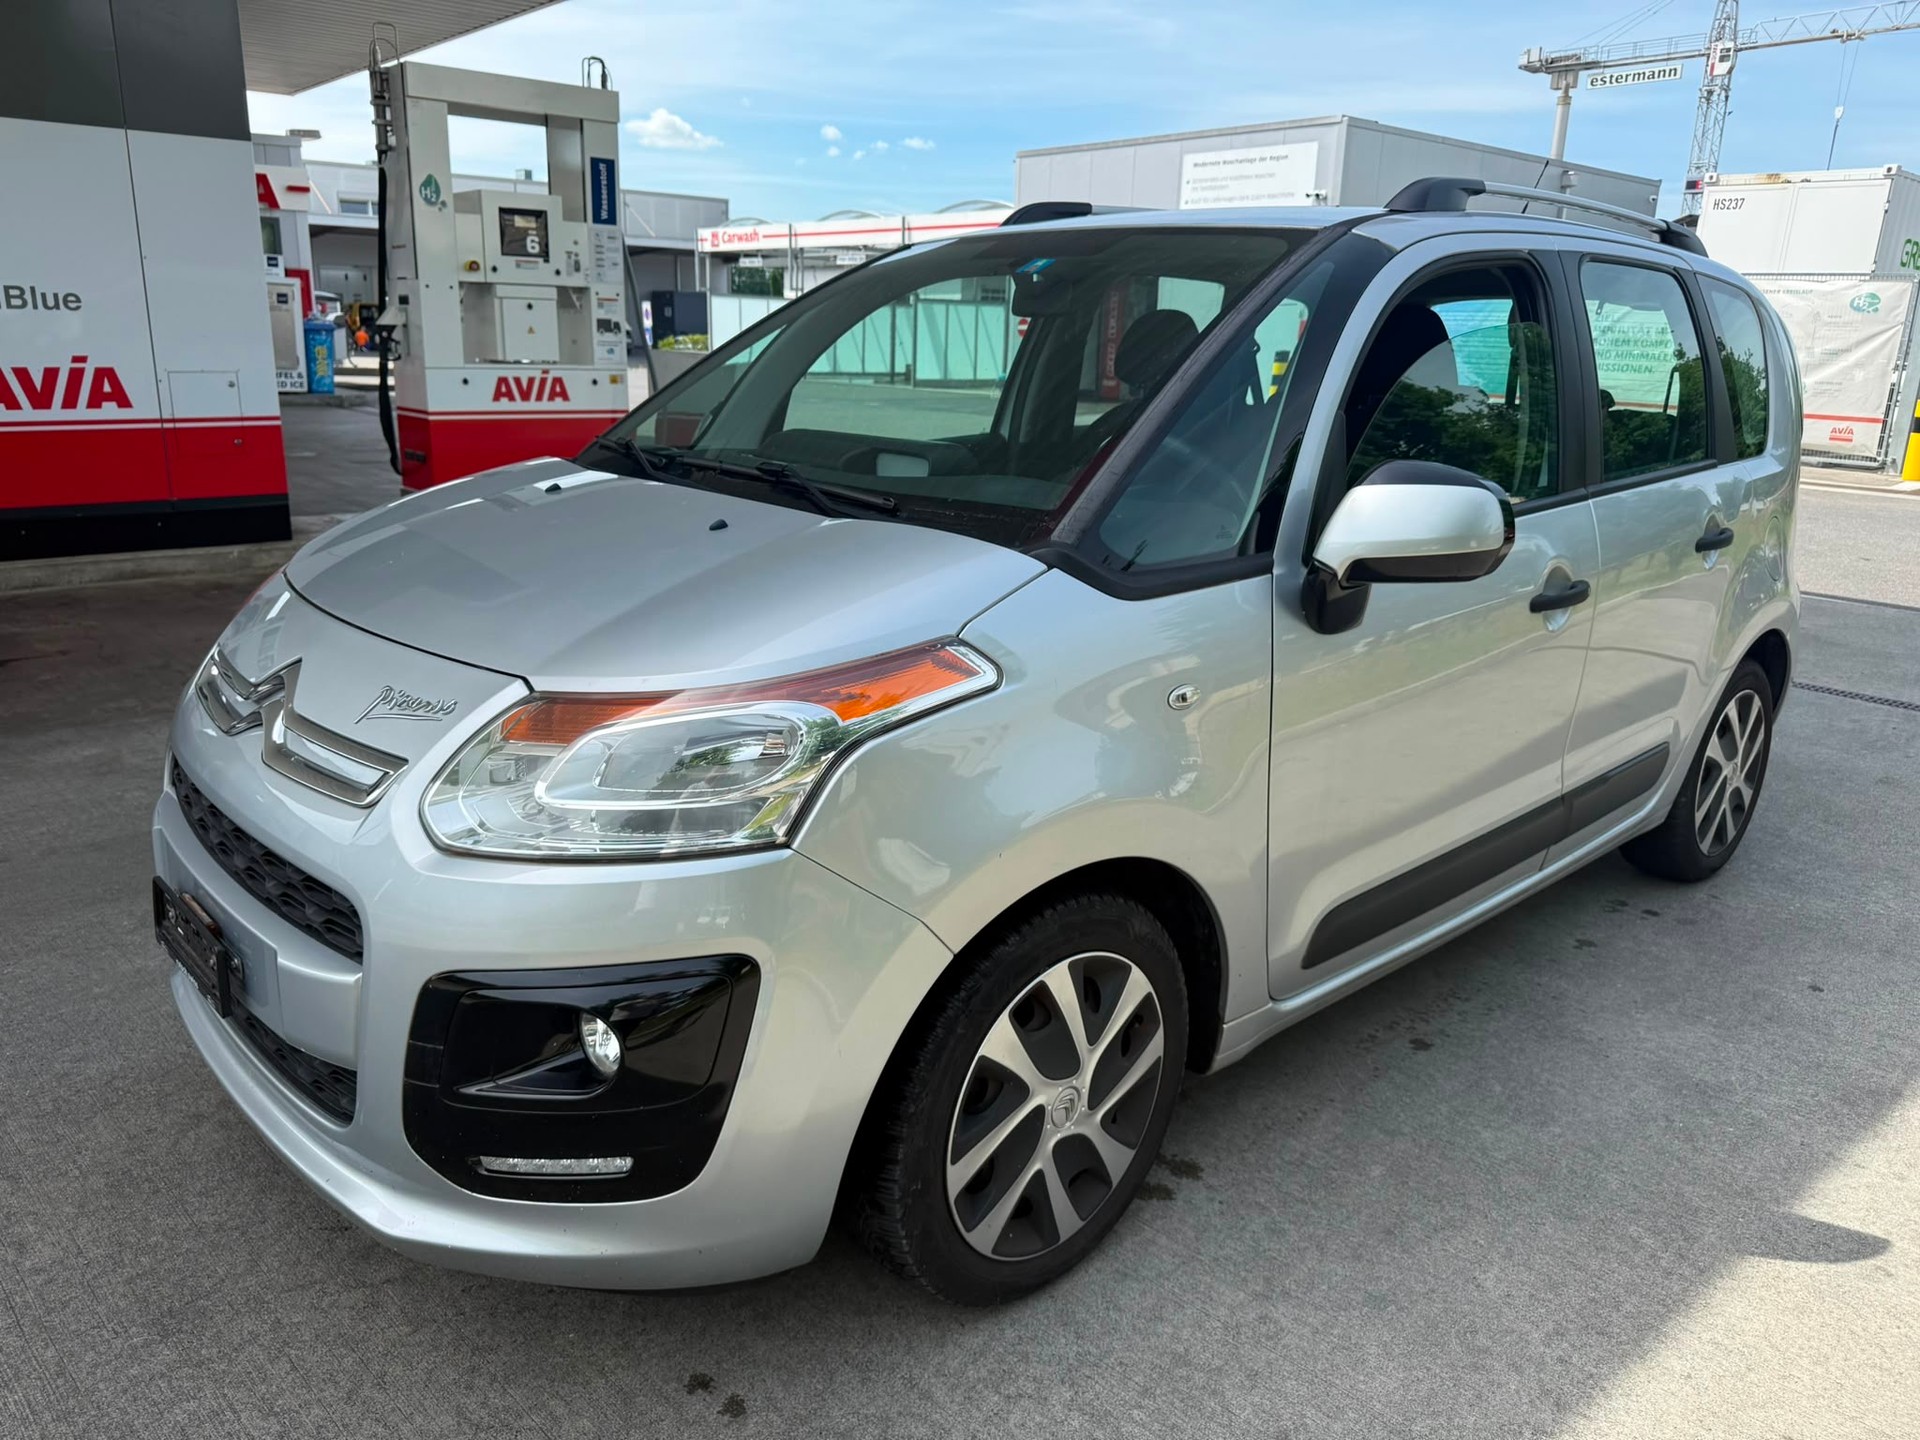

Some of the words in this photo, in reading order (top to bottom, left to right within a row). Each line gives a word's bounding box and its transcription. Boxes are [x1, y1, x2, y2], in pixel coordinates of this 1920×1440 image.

[1590, 67, 1678, 87] estermann
[599, 162, 609, 220] Wasserstoff
[1713, 198, 1745, 210] HS237
[722, 228, 760, 244] Carwash
[0, 285, 83, 311] Blue
[492, 368, 571, 402] AVIA
[1830, 425, 1855, 436] AVIA
